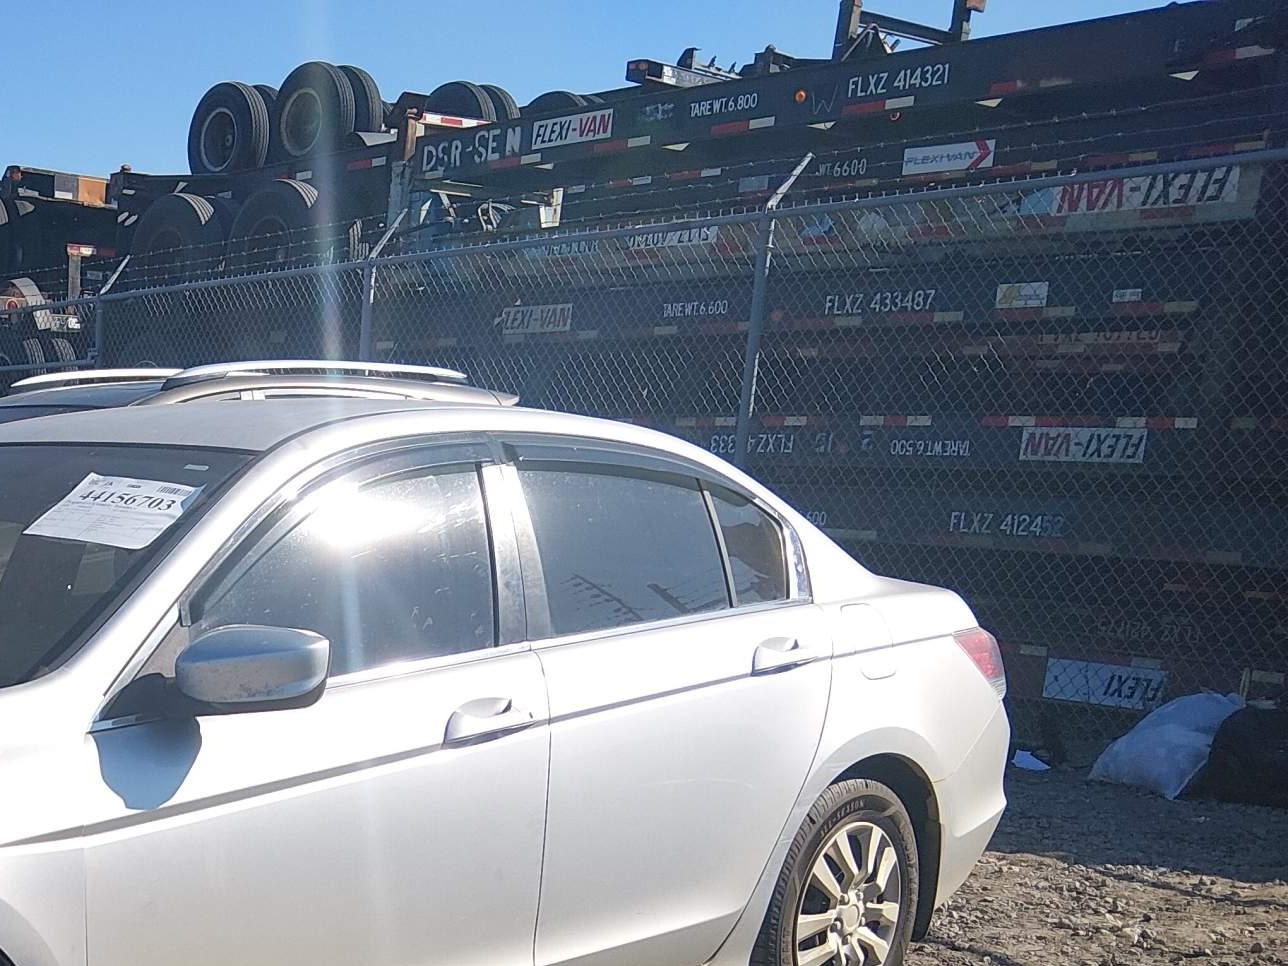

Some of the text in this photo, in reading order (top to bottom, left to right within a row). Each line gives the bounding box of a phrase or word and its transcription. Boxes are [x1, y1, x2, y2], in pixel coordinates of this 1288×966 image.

[848, 63, 950, 99] FLXZ 414321
[533, 111, 612, 146] FLEXI-VAN
[1060, 168, 1231, 213] FLEXI-VAN
[825, 289, 936, 315] FLXZ 433487
[1024, 430, 1143, 460] FLEXI-VAN
[80, 489, 177, 511] 44156703
[950, 511, 994, 533] FLXZ
